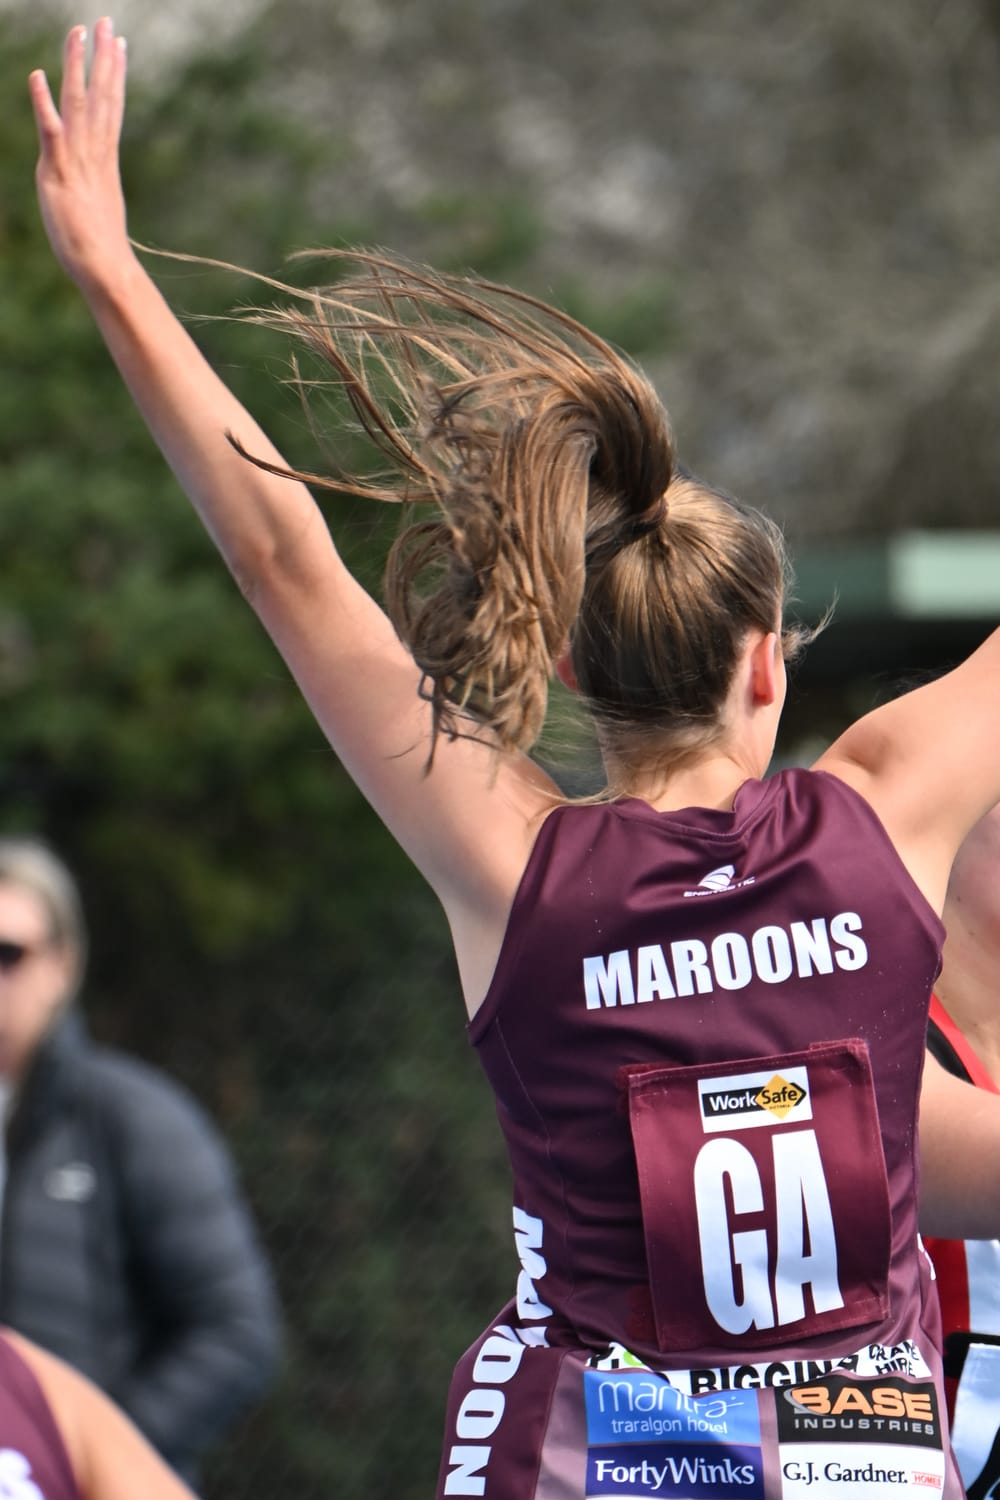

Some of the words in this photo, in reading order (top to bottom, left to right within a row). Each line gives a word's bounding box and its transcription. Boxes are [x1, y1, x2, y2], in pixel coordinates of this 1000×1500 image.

[582, 912, 869, 1011] MAROONS
[709, 1086, 798, 1111] WorkSafe
[693, 1129, 845, 1336] GA
[788, 1386, 934, 1422] BASE
[611, 1416, 683, 1436] traralgon
[687, 1416, 728, 1435] hotel
[794, 1418, 935, 1436] INDUSTRIES
[783, 1462, 819, 1486] G.J.
[824, 1462, 908, 1484] Gardner.
